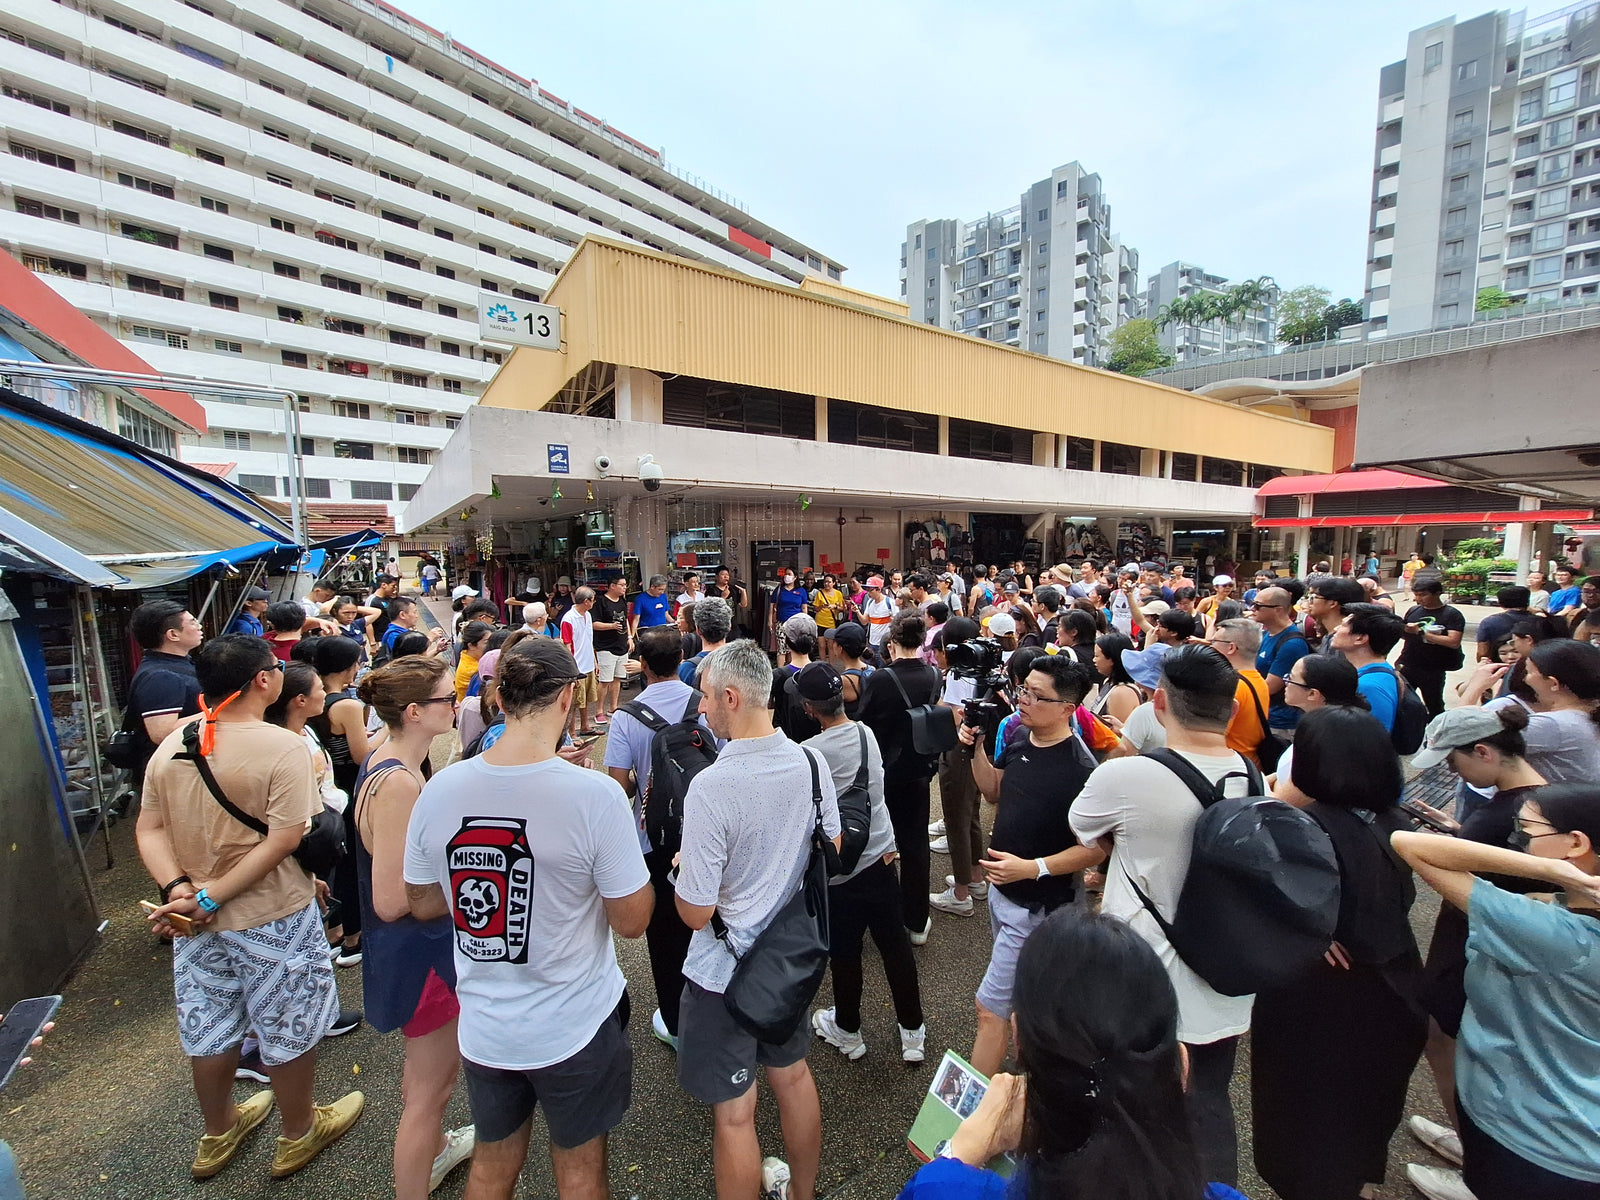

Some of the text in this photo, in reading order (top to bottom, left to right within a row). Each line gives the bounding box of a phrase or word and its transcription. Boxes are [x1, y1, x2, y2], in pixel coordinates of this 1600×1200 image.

[523, 312, 551, 337] 13
[454, 852, 503, 867] MISSING
[509, 869, 529, 946] DEATH
